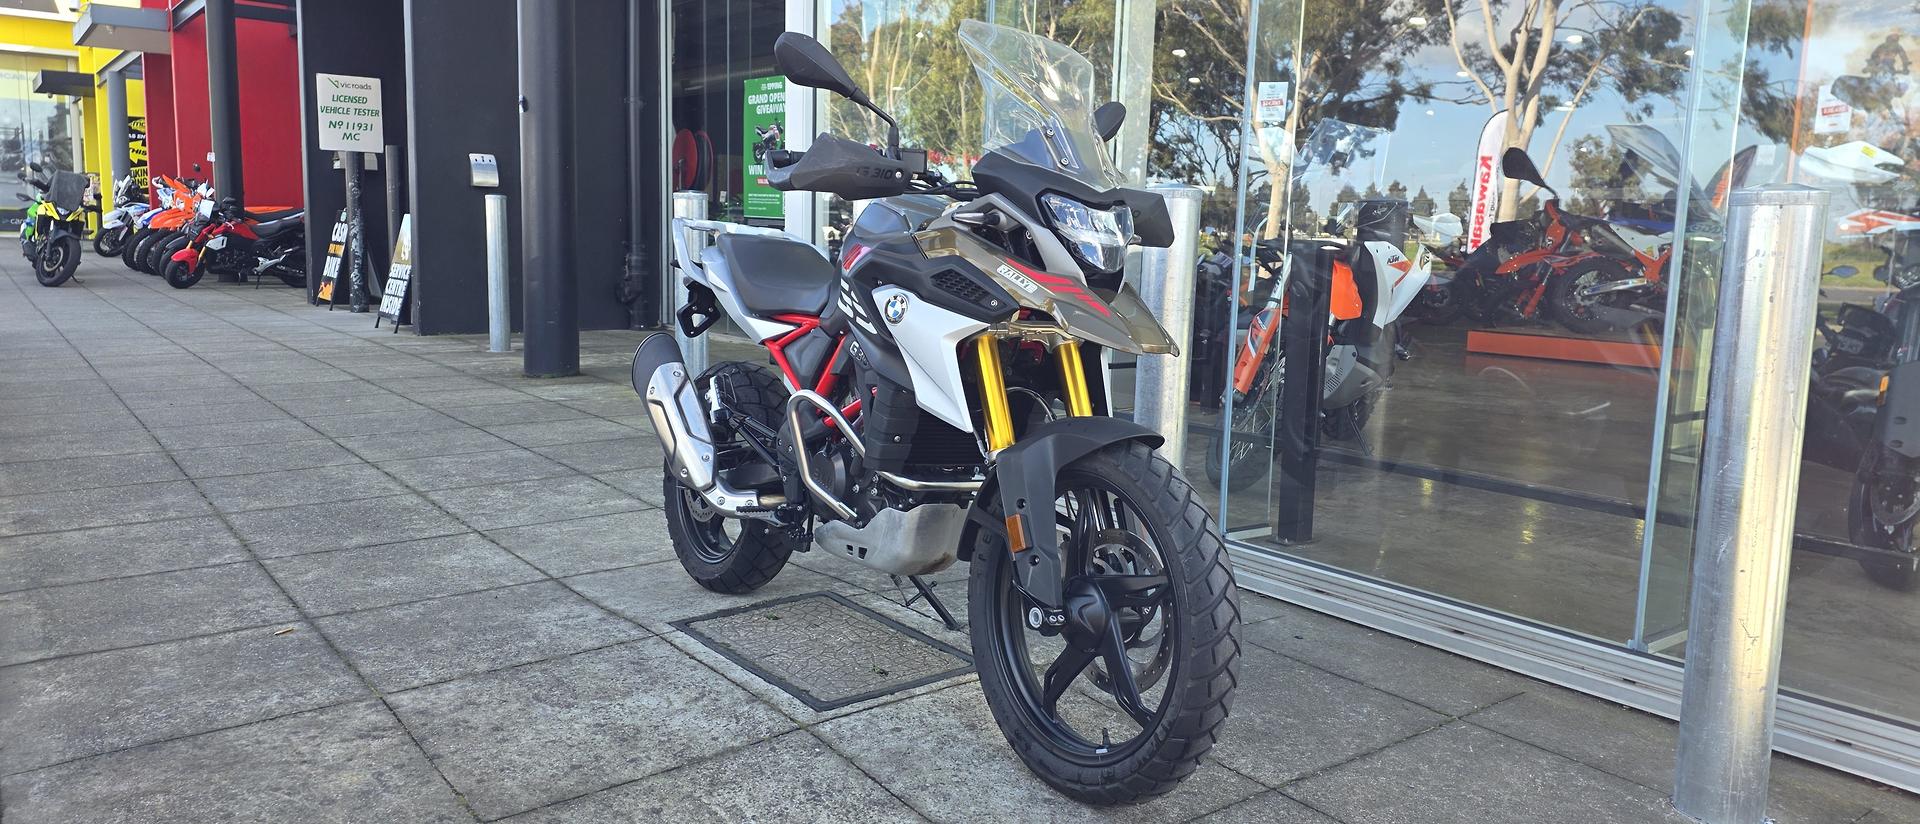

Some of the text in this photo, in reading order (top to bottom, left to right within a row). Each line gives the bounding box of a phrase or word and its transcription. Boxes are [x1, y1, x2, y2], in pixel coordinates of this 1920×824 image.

[332, 94, 368, 104] LICENSED
[748, 92, 785, 105] GRAND OPEN
[320, 105, 380, 117] VEHICLE TESTER
[342, 132, 360, 141] MC
[748, 164, 763, 176] WIN
[1470, 155, 1493, 250] Kawasak
